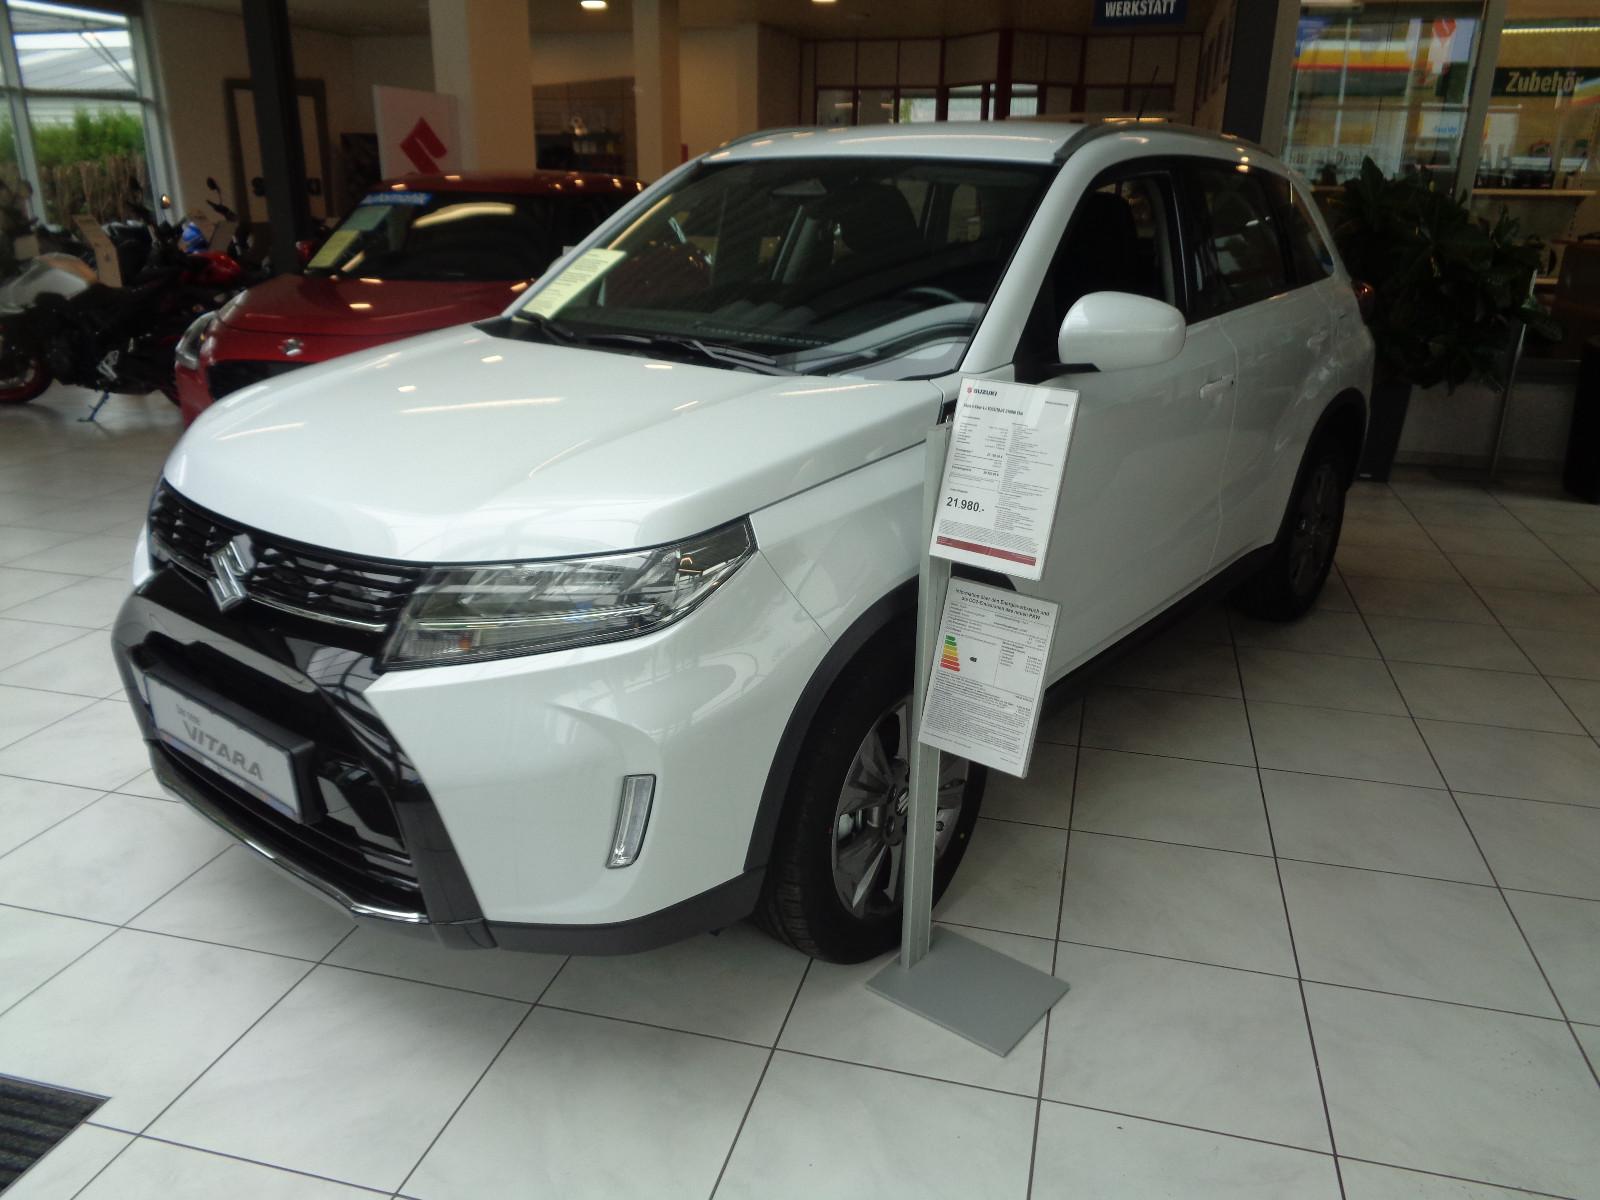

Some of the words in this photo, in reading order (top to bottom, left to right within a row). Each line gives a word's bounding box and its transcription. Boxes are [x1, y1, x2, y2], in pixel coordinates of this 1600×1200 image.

[1105, 0, 1177, 17] WERKSTATT
[1505, 71, 1585, 93] Zubehör
[973, 388, 998, 397] SUZUKI
[183, 719, 264, 782] VITARA
